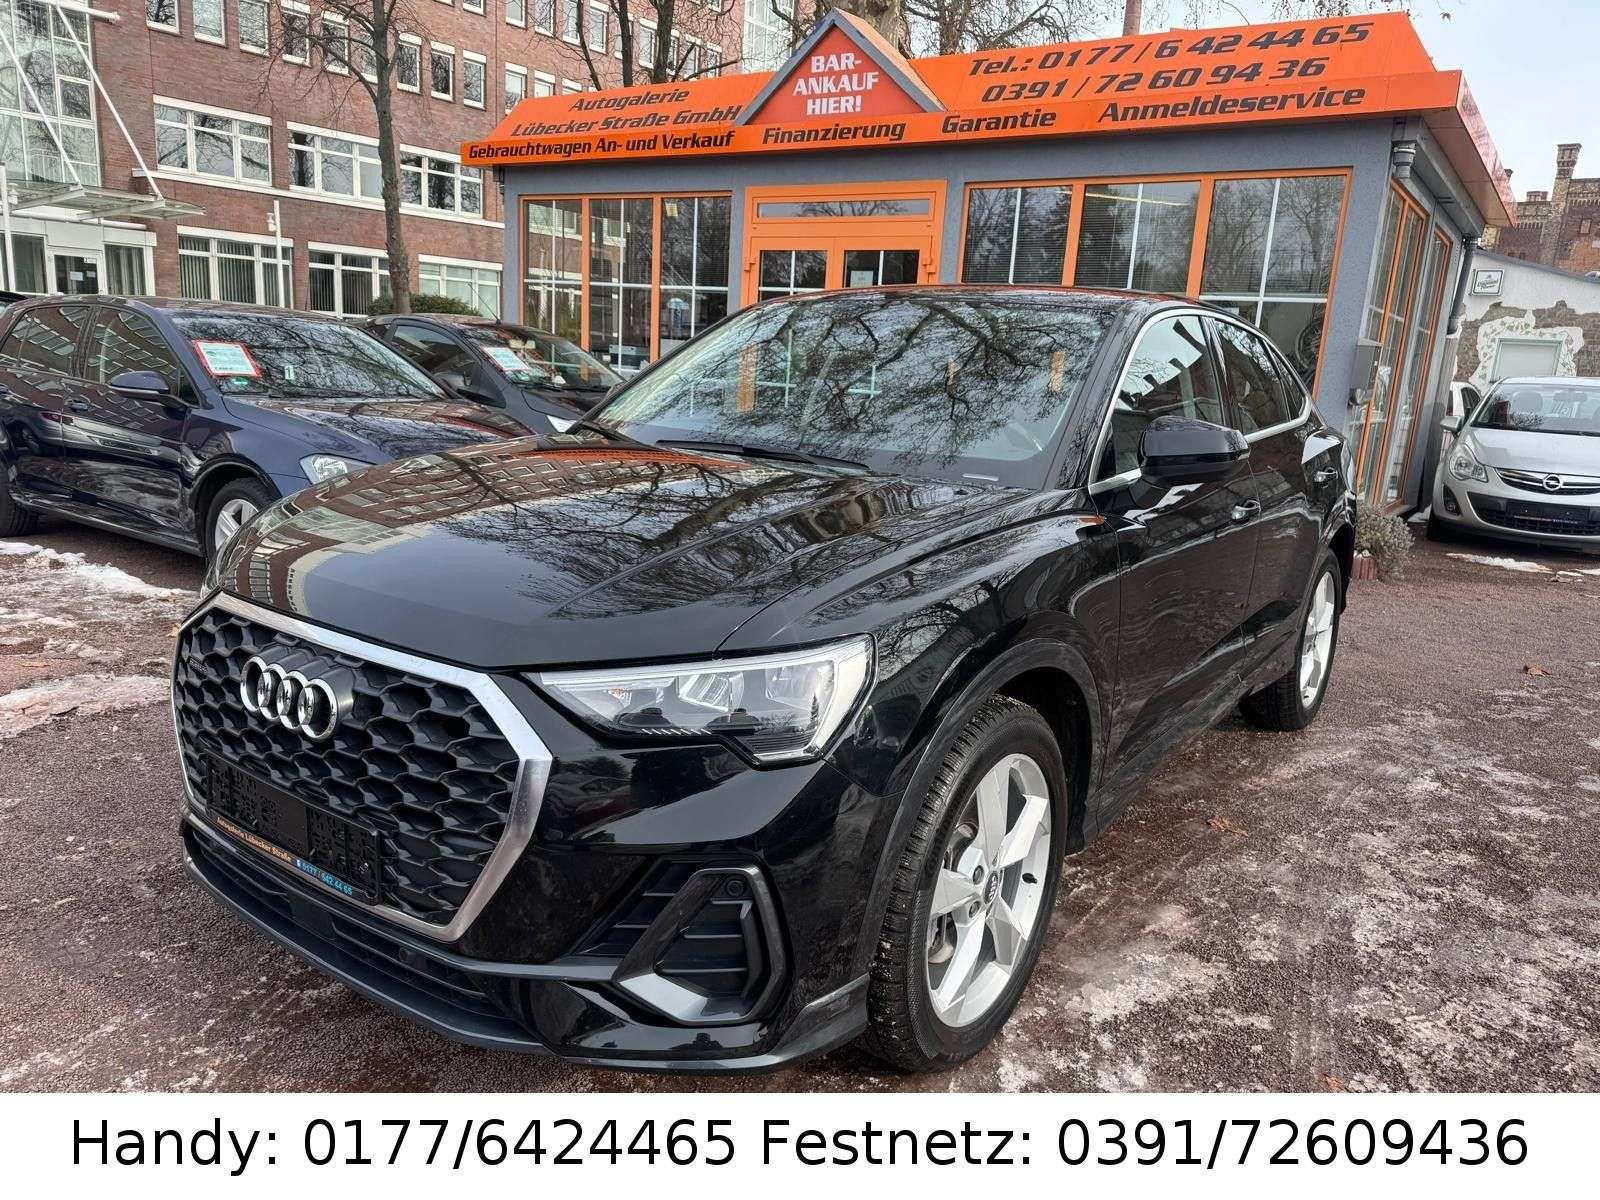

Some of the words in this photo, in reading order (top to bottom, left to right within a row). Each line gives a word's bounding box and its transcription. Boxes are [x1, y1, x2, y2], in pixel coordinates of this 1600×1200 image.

[811, 52, 862, 71] BAR-
[968, 56, 1033, 76] Tel.:
[1038, 44, 1134, 71] 0177
[1186, 34, 1243, 55] 42
[1248, 28, 1306, 50] 44
[1311, 22, 1374, 46] 65
[792, 71, 880, 96] ANKAUF
[981, 78, 1069, 103] 0391
[1147, 67, 1203, 90] 60
[1206, 62, 1263, 85] 94
[1269, 57, 1331, 80] 36
[568, 88, 690, 112] Autogalerie
[806, 95, 862, 116] HIER!
[1098, 86, 1366, 123] Anmeldeservice
[511, 120, 598, 137] Lübecker
[601, 113, 671, 130] Straße
[672, 105, 742, 125] GmbH
[762, 121, 907, 145] Finanzierung
[941, 109, 1057, 134] Garantie
[468, 141, 592, 159] Gebrauchtwagen
[595, 137, 622, 153] An-
[625, 133, 657, 151] und
[662, 130, 735, 150] Verkauf
